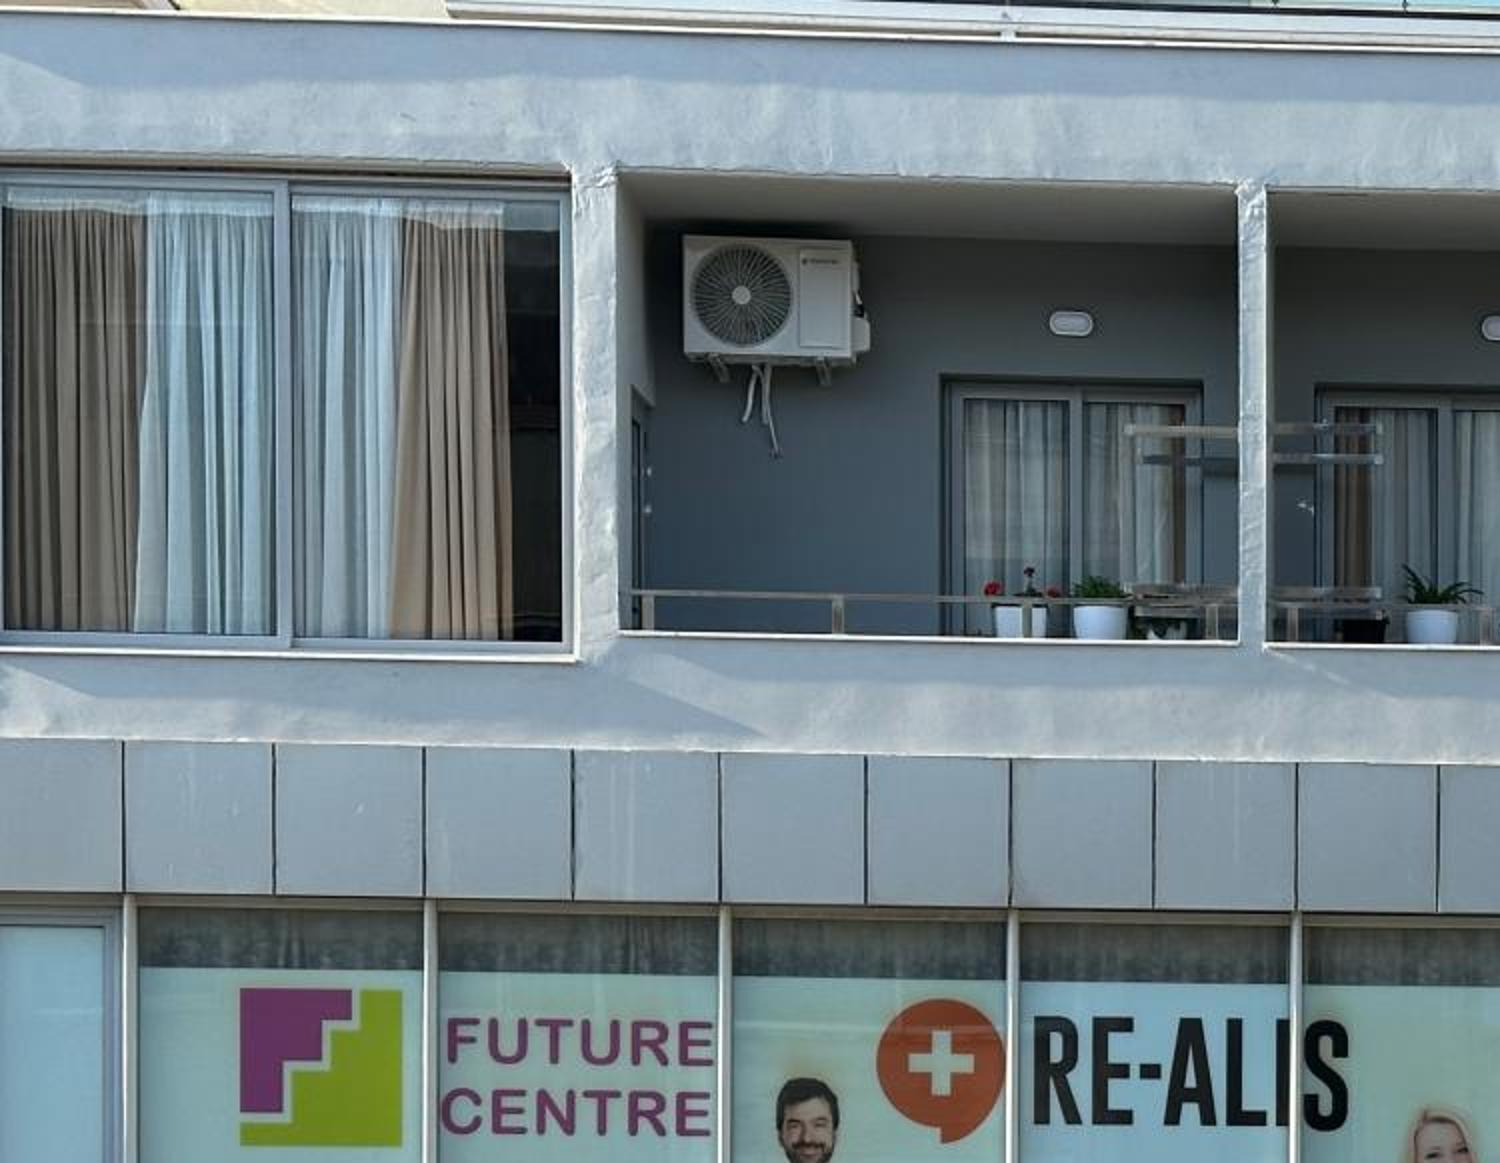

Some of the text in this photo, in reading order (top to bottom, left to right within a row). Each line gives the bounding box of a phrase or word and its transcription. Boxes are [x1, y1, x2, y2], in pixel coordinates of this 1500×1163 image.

[446, 1017, 714, 1067] FUTURE
[1033, 1016, 1349, 1132] RE-ALIS
[441, 1088, 712, 1137] CENTRE
